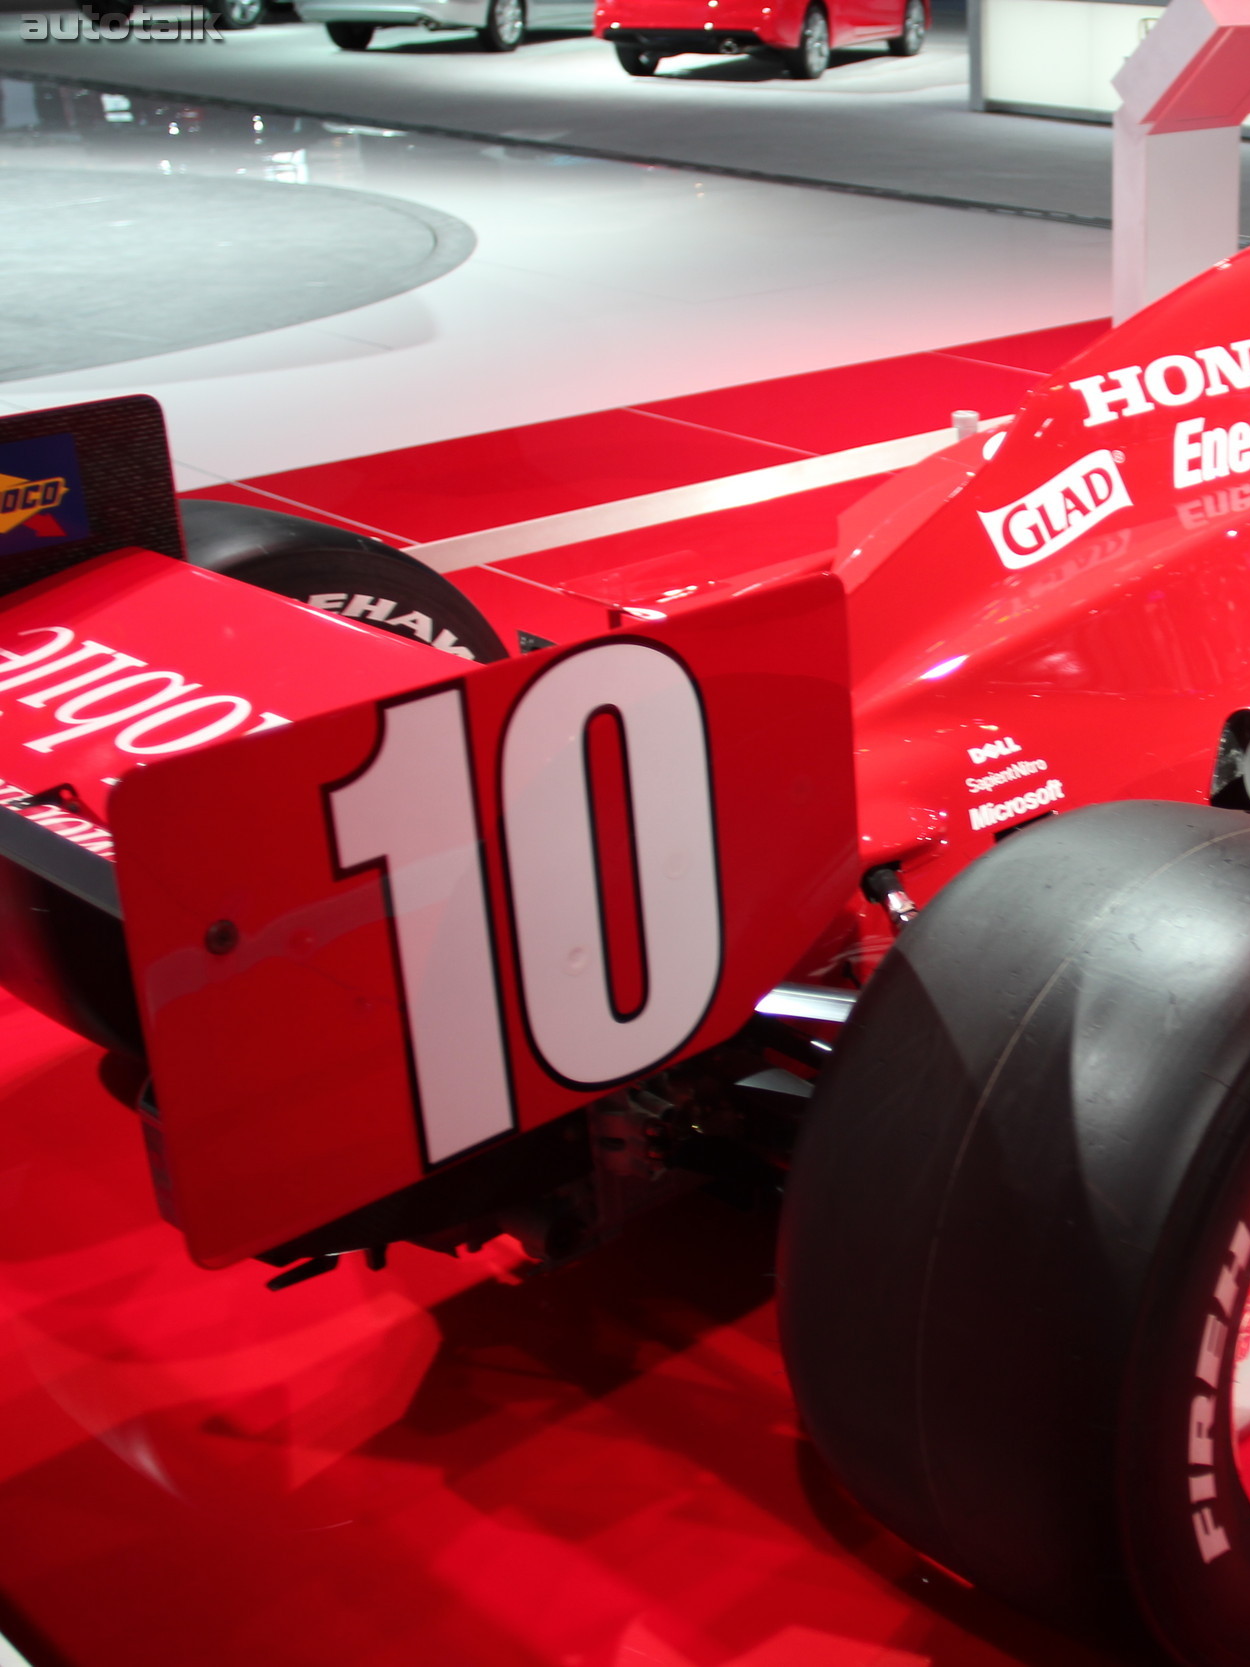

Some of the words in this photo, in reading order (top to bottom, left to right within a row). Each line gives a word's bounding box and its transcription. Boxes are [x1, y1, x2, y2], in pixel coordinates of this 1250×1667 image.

[1002, 465, 1115, 556] GLAD
[968, 779, 1065, 831] Microsoft
[322, 634, 726, 1174] 10
